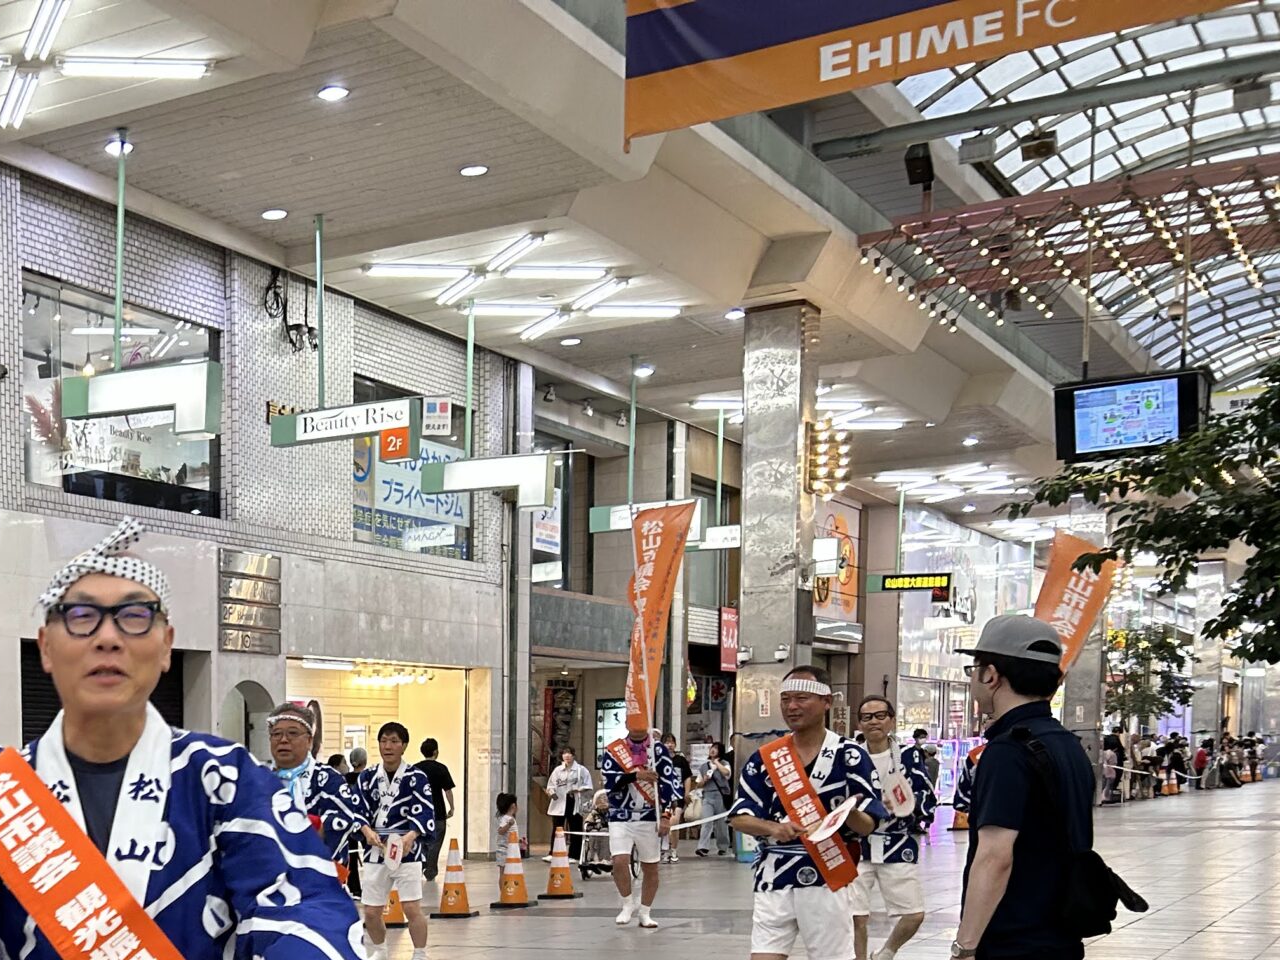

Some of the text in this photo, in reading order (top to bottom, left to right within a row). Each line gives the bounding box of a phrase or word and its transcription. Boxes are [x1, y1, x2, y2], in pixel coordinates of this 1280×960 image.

[819, 0, 1078, 82] EHIME FC
[303, 409, 361, 435] Beauty
[365, 406, 405, 427] Rise
[386, 435, 404, 452] 2F
[114, 772, 165, 863] 松山
